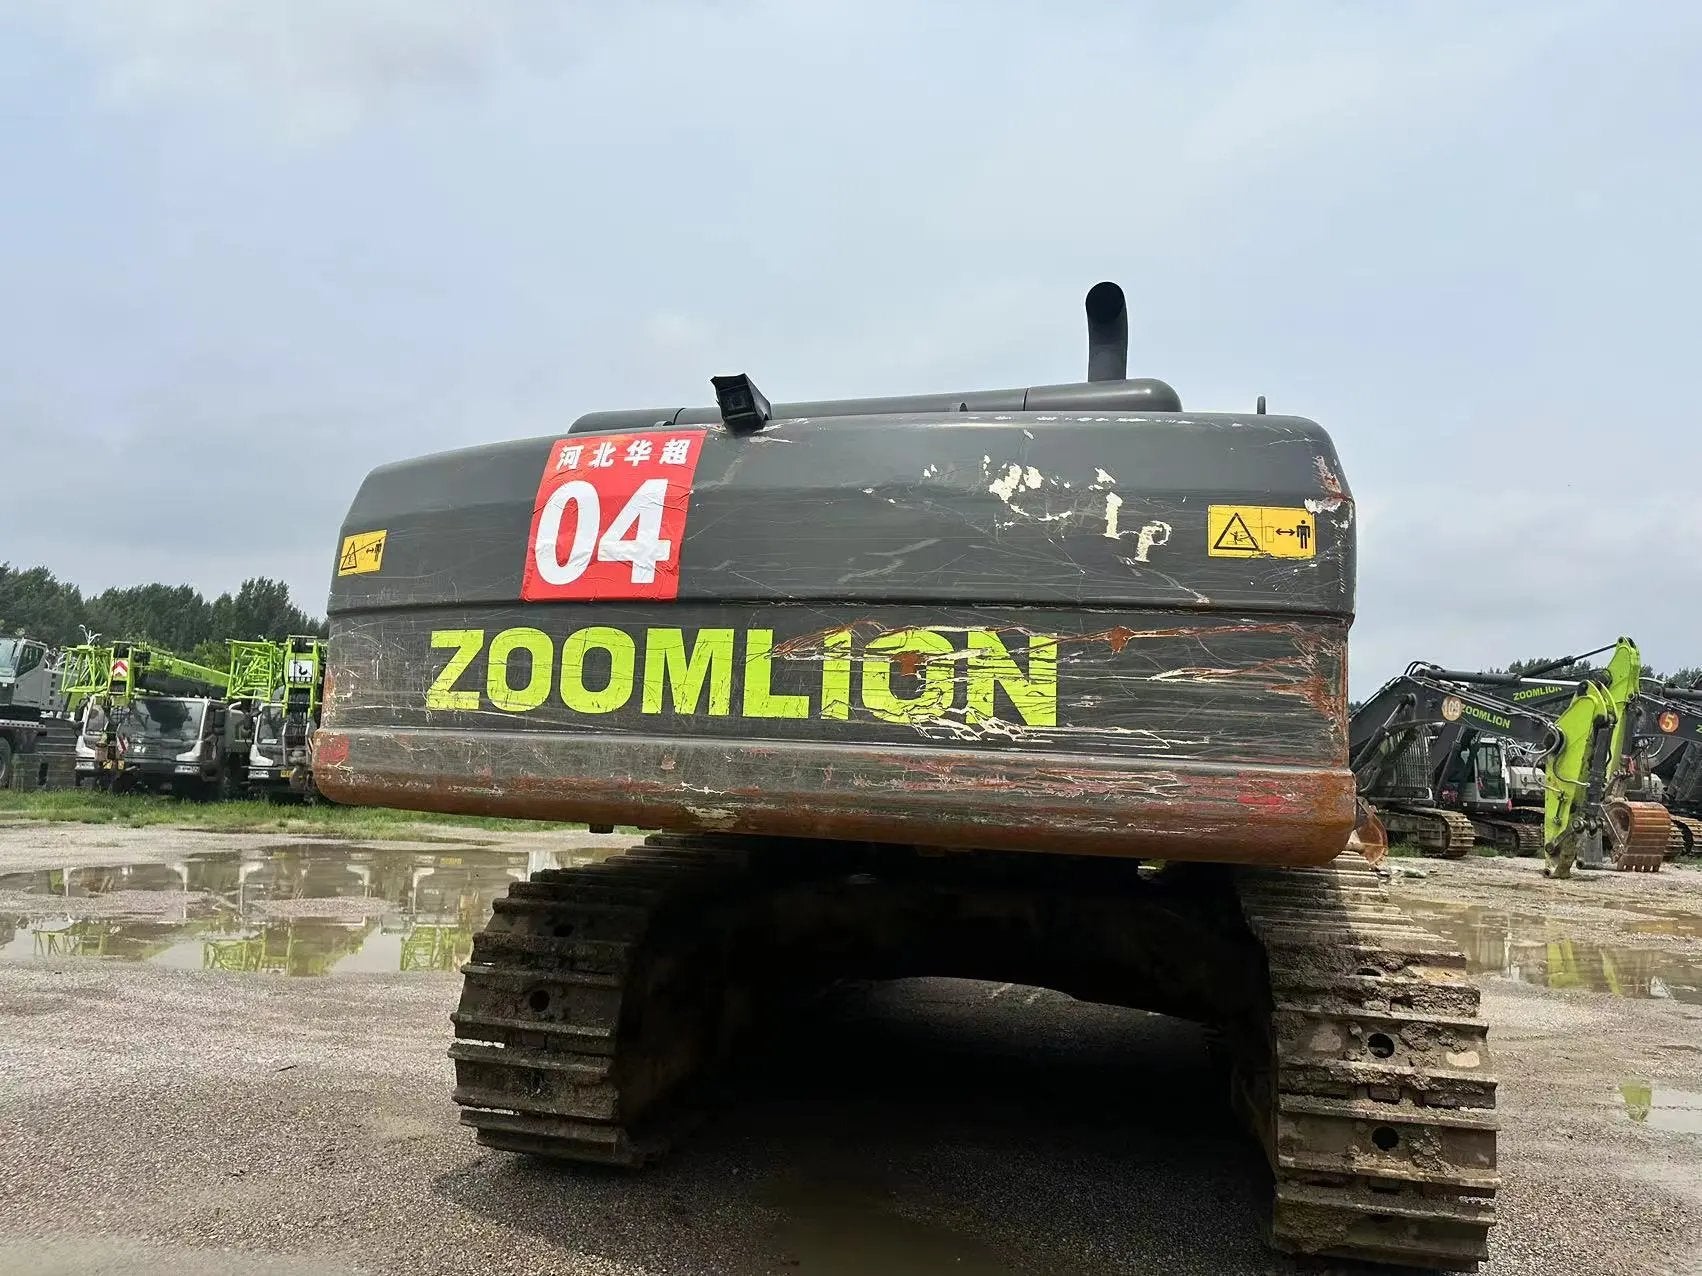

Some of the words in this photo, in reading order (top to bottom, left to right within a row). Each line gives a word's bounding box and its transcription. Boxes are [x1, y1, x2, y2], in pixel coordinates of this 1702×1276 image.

[556, 438, 691, 471] 河北华超
[536, 478, 671, 585] 04
[427, 627, 1058, 727] ZOOMLION
[1461, 703, 1510, 729] ZOOMLION
[1662, 712, 1675, 730] 5
